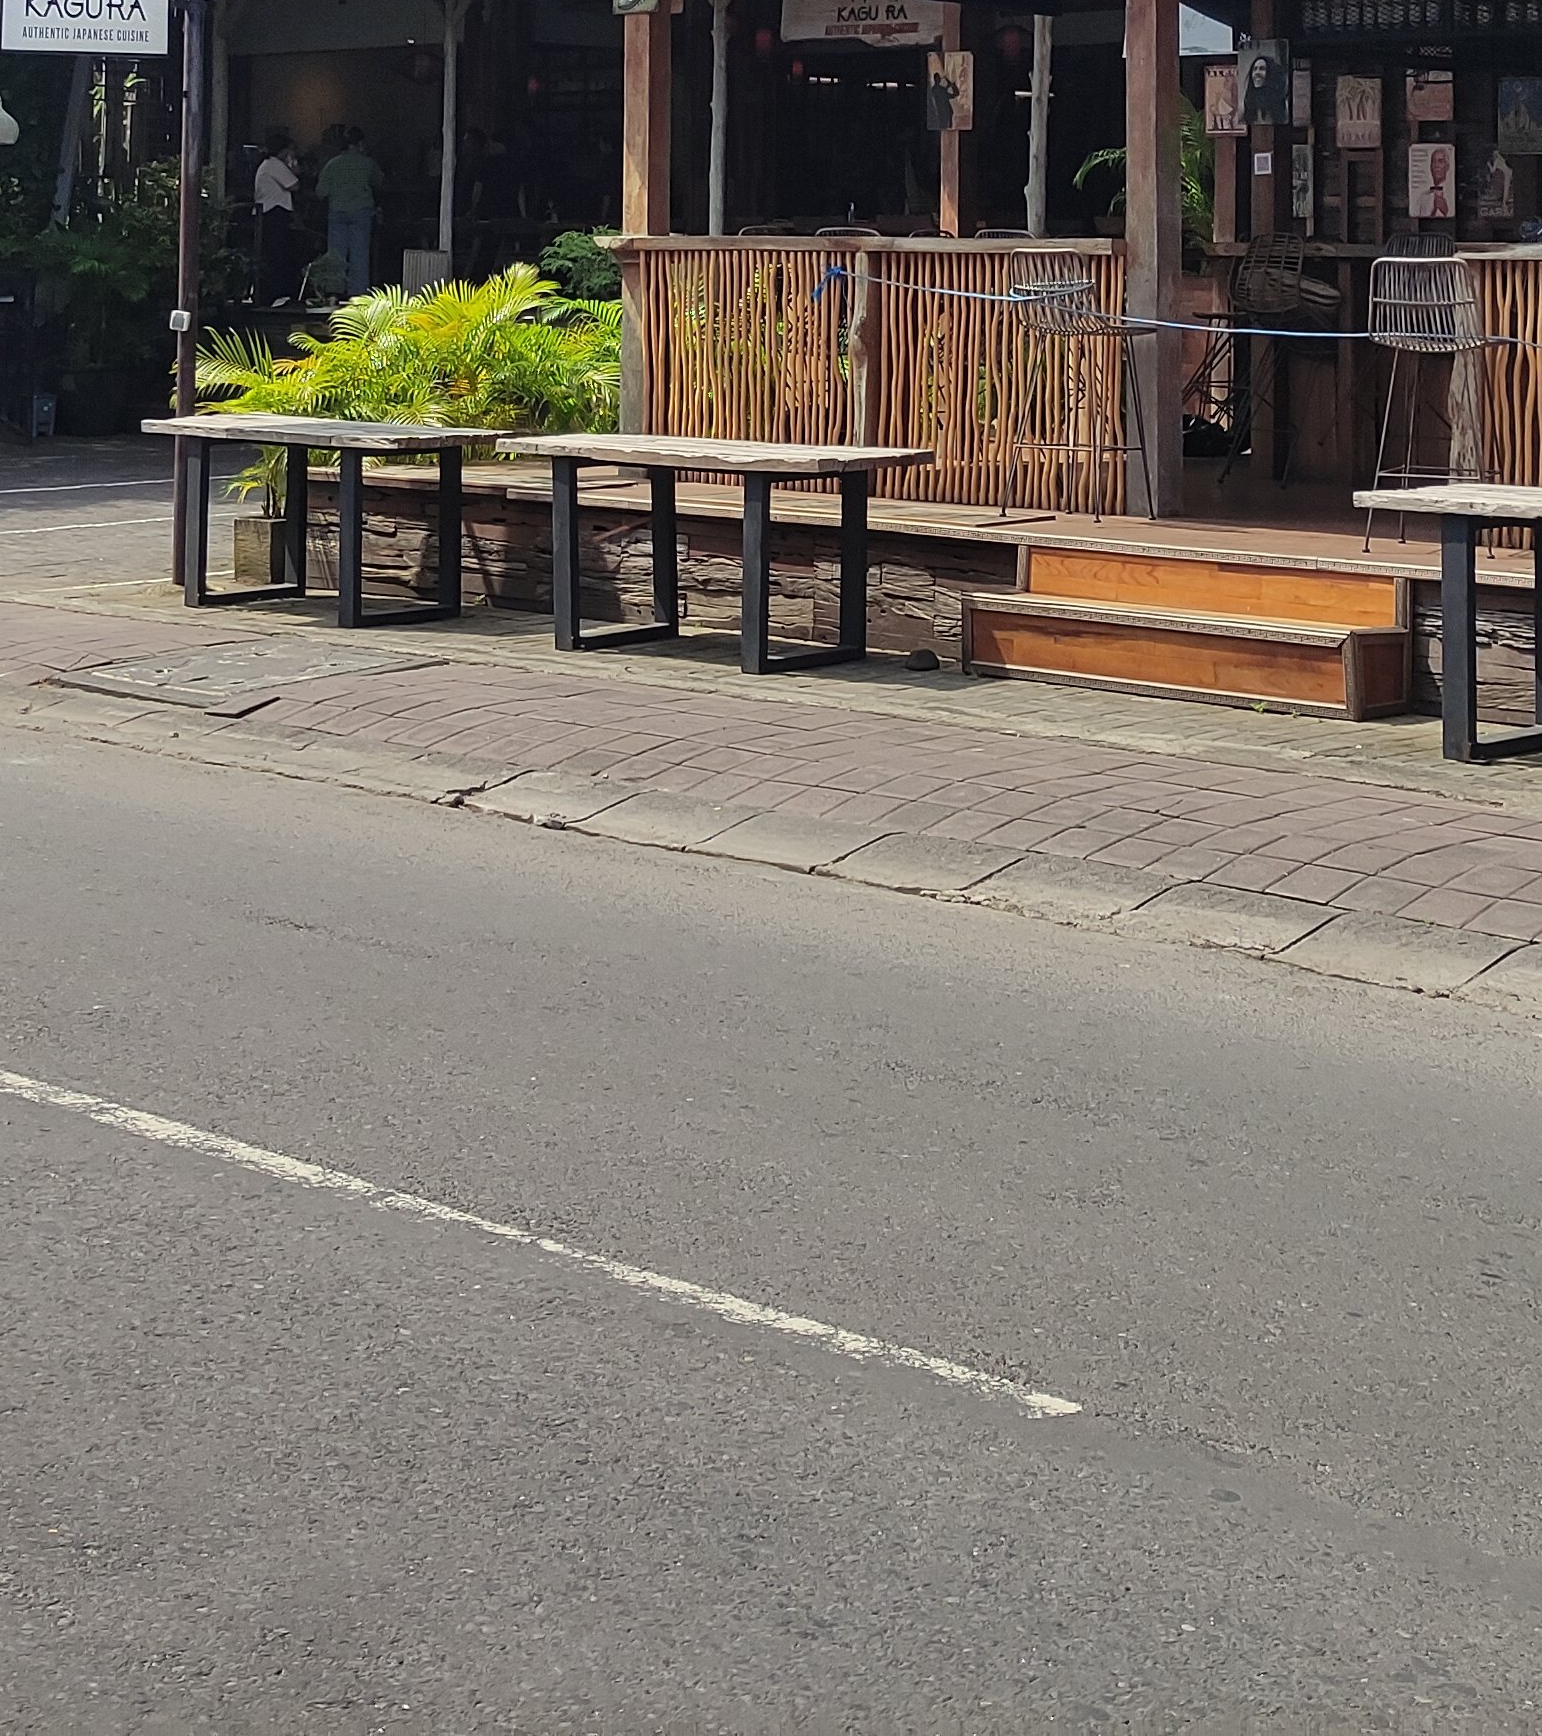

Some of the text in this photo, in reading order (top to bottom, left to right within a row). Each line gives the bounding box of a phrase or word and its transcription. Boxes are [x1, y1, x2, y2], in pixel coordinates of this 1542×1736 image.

[22, 26, 149, 42] AUTHENTIC JAPANESE CUISINE
